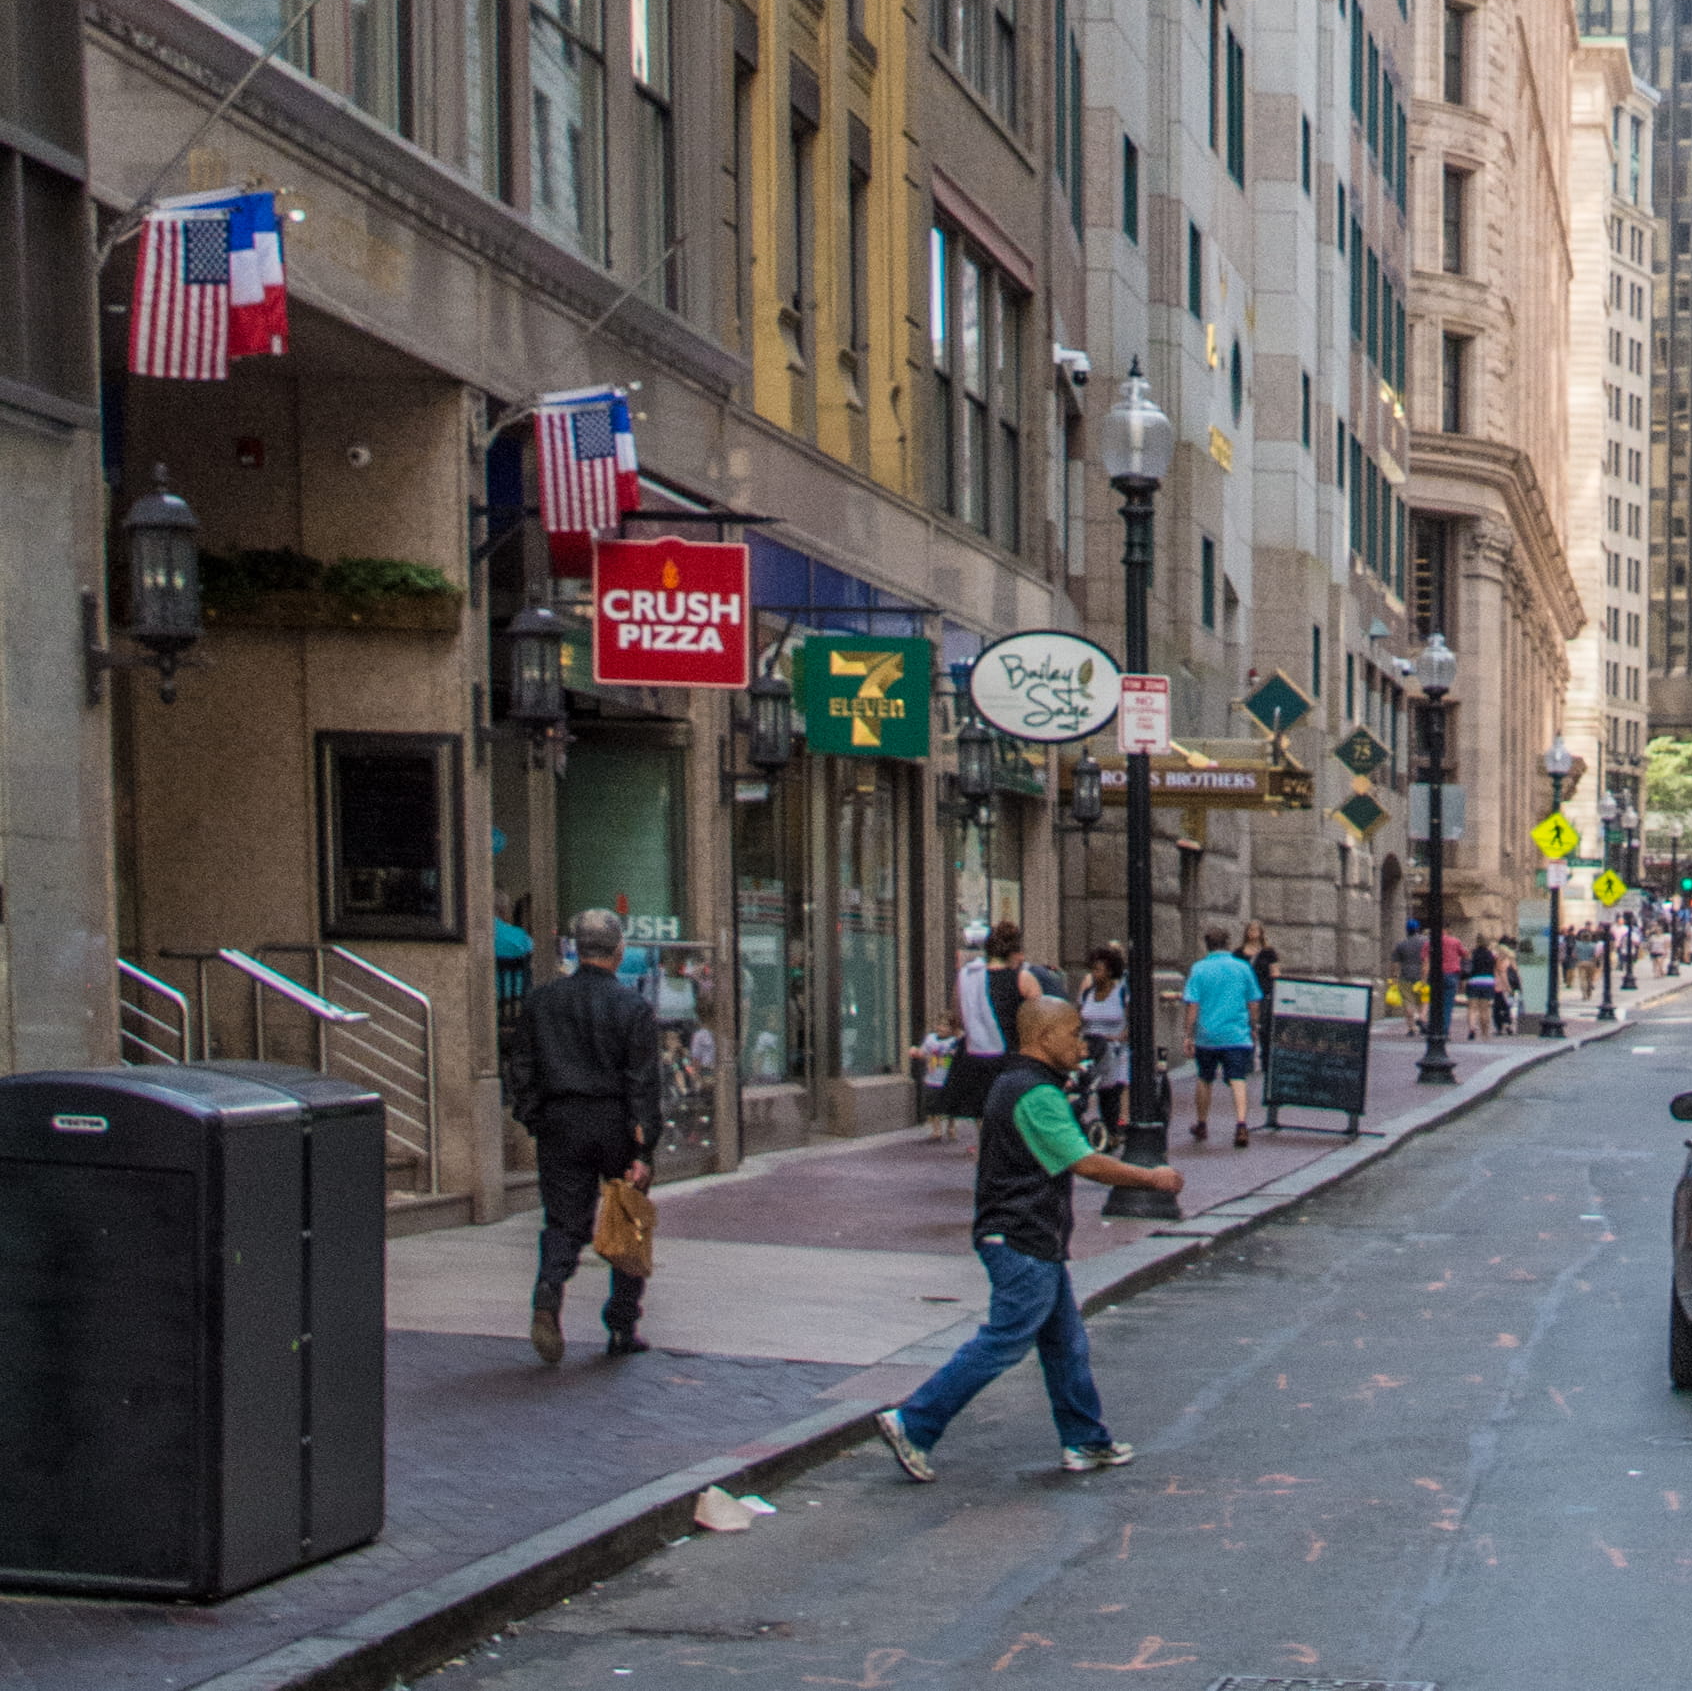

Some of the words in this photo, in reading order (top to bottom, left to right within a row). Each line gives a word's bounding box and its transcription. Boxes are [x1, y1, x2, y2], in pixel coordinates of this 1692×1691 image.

[602, 589, 740, 625] CRUSH
[618, 623, 724, 653] PIZZA
[999, 653, 1087, 704] Bailey
[829, 650, 905, 747] 7
[1023, 683, 1093, 732] Sage
[1165, 772, 1256, 788] BROTHERS
[622, 916, 680, 940] USH
